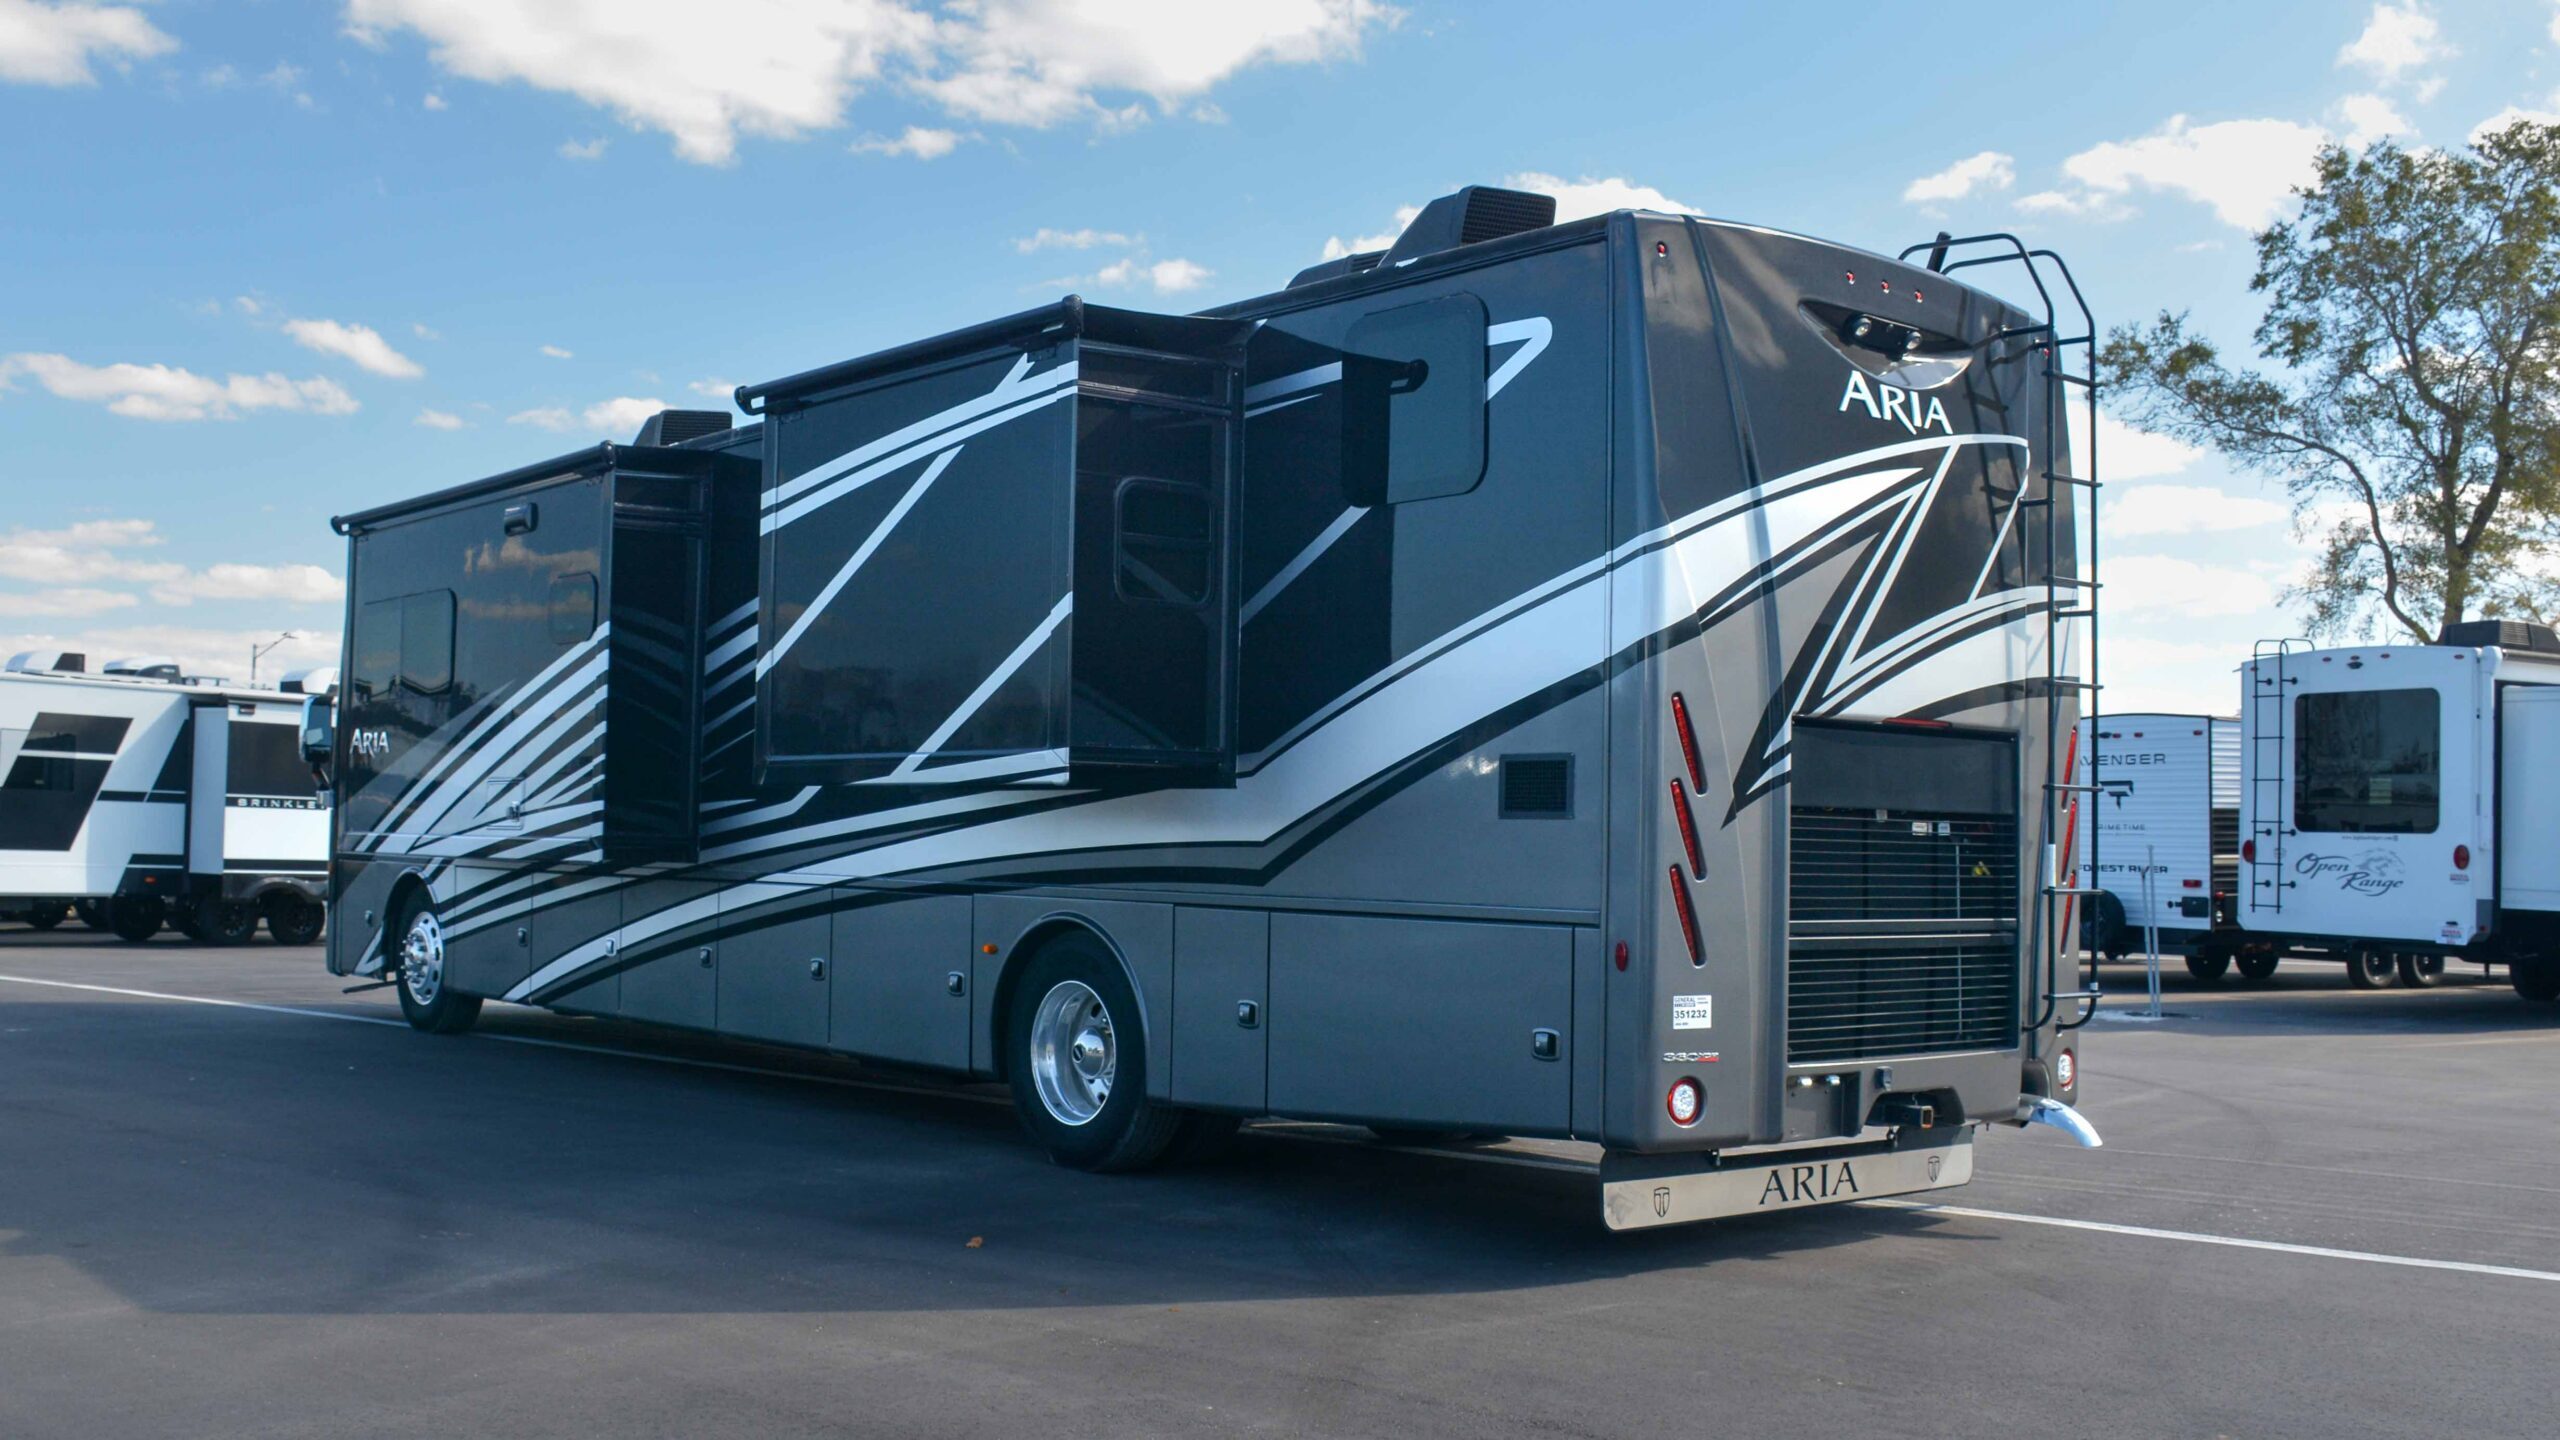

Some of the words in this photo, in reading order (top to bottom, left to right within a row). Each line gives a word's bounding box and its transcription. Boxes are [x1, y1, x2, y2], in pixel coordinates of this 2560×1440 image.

[1838, 370, 1954, 435] ARIA
[349, 728, 390, 759] ARIA
[237, 798, 325, 809] BRINKLE
[2295, 852, 2352, 880] Open
[2336, 871, 2404, 897] Range
[1674, 1009, 1707, 1019] 351232
[1759, 1162, 1859, 1206] ARIA
